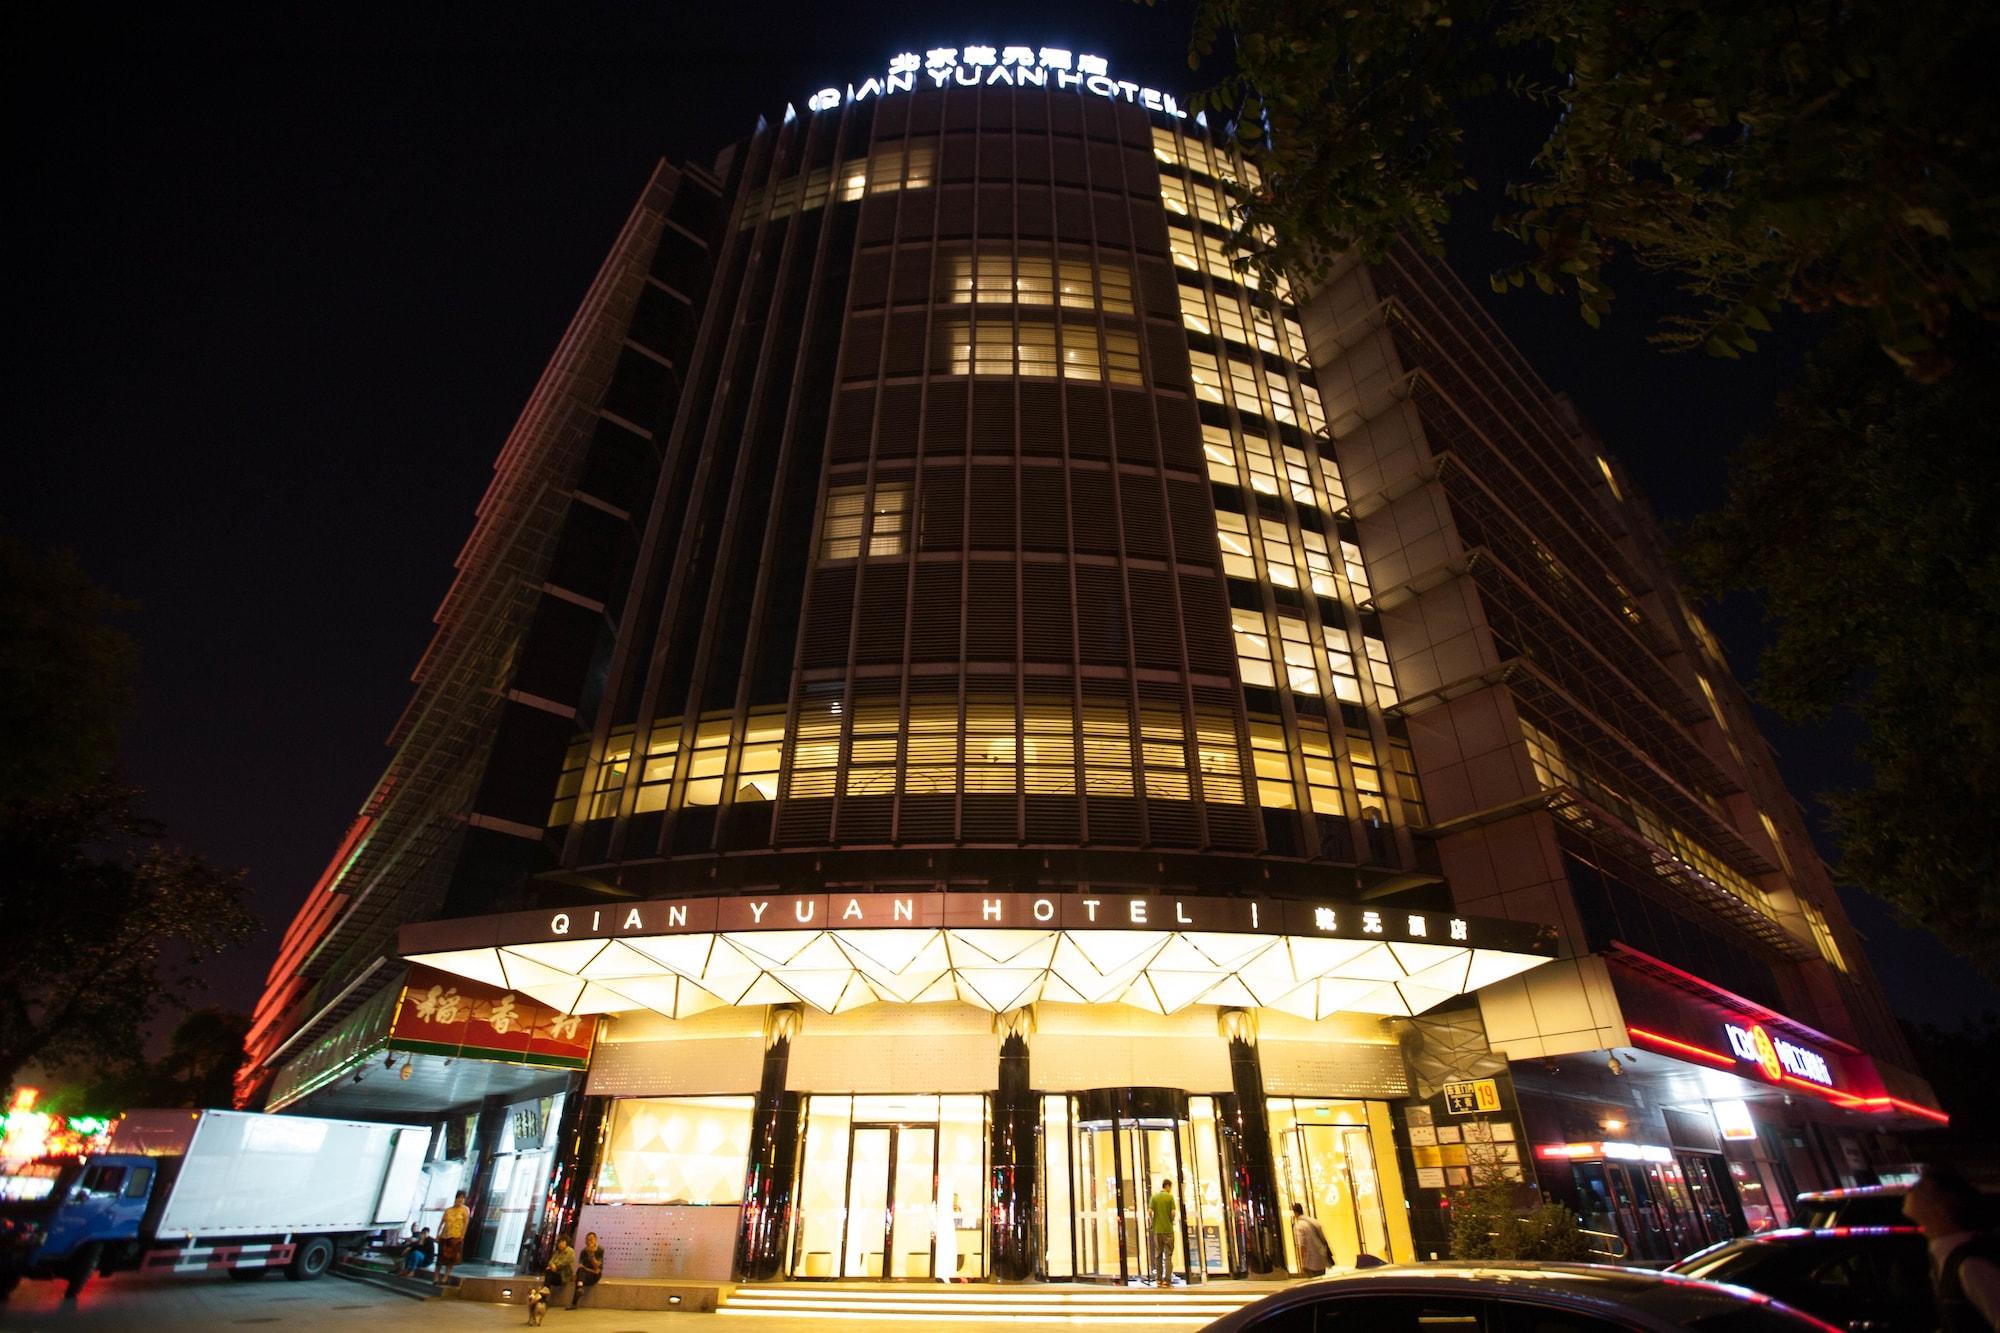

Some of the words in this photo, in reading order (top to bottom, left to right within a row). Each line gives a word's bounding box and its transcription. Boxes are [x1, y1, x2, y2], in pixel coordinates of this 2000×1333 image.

[808, 71, 915, 111] QIAN
[928, 66, 1044, 88] YUAN
[1058, 70, 1187, 118] HOTEL
[551, 905, 687, 935] QIAN
[750, 898, 913, 924] YUAN
[983, 899, 1193, 924] HOTEL
[1315, 907, 1468, 941] 乾元酒店
[411, 985, 581, 1040] 稻香村
[1478, 1085, 1494, 1106] 19
